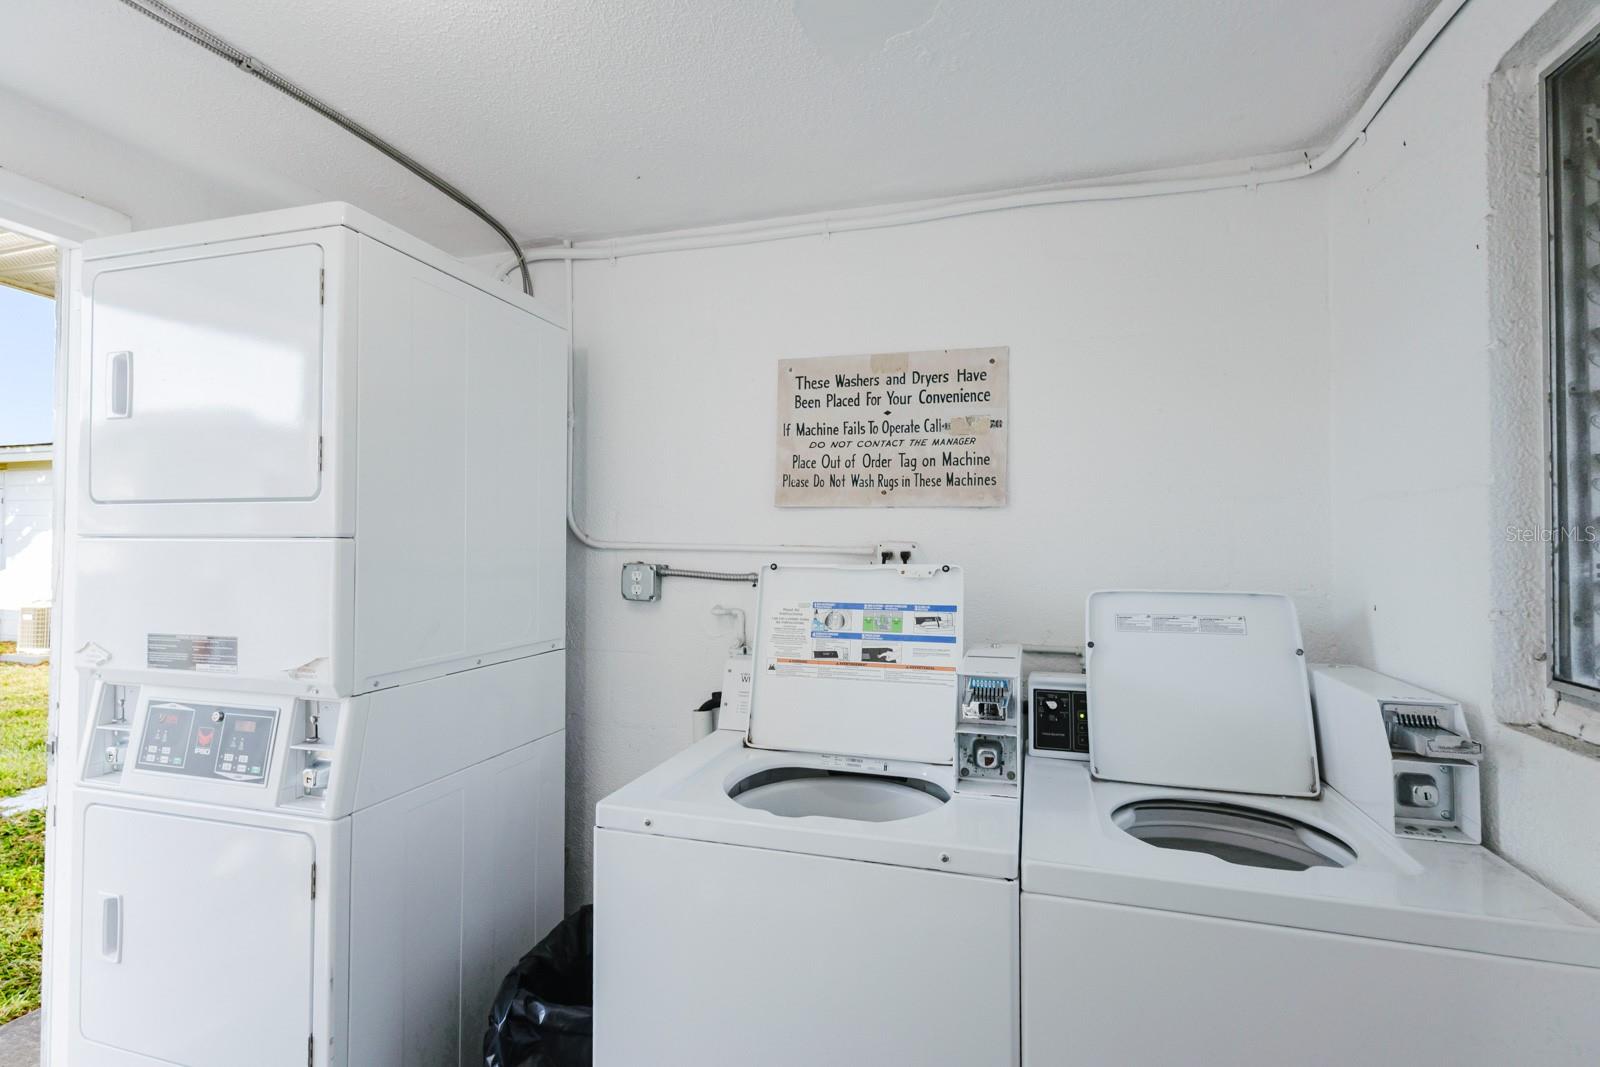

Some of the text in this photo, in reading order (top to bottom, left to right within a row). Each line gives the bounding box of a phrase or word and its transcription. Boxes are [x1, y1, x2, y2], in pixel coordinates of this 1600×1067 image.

[795, 369, 987, 390] These Washers and Dryers Have
[795, 388, 991, 408] Been Placed For Your Convenience
[783, 423, 791, 436] If
[796, 422, 839, 436] Machine
[844, 421, 865, 435] Fails
[868, 421, 878, 434] To
[882, 419, 920, 436] Operate
[857, 439, 904, 447] CONTACT
[932, 438, 976, 446] MANAGER
[793, 451, 990, 471] Place Out of Order Tag on Machine
[783, 472, 996, 491] Please Do Not Wash Rugs in These Machines
